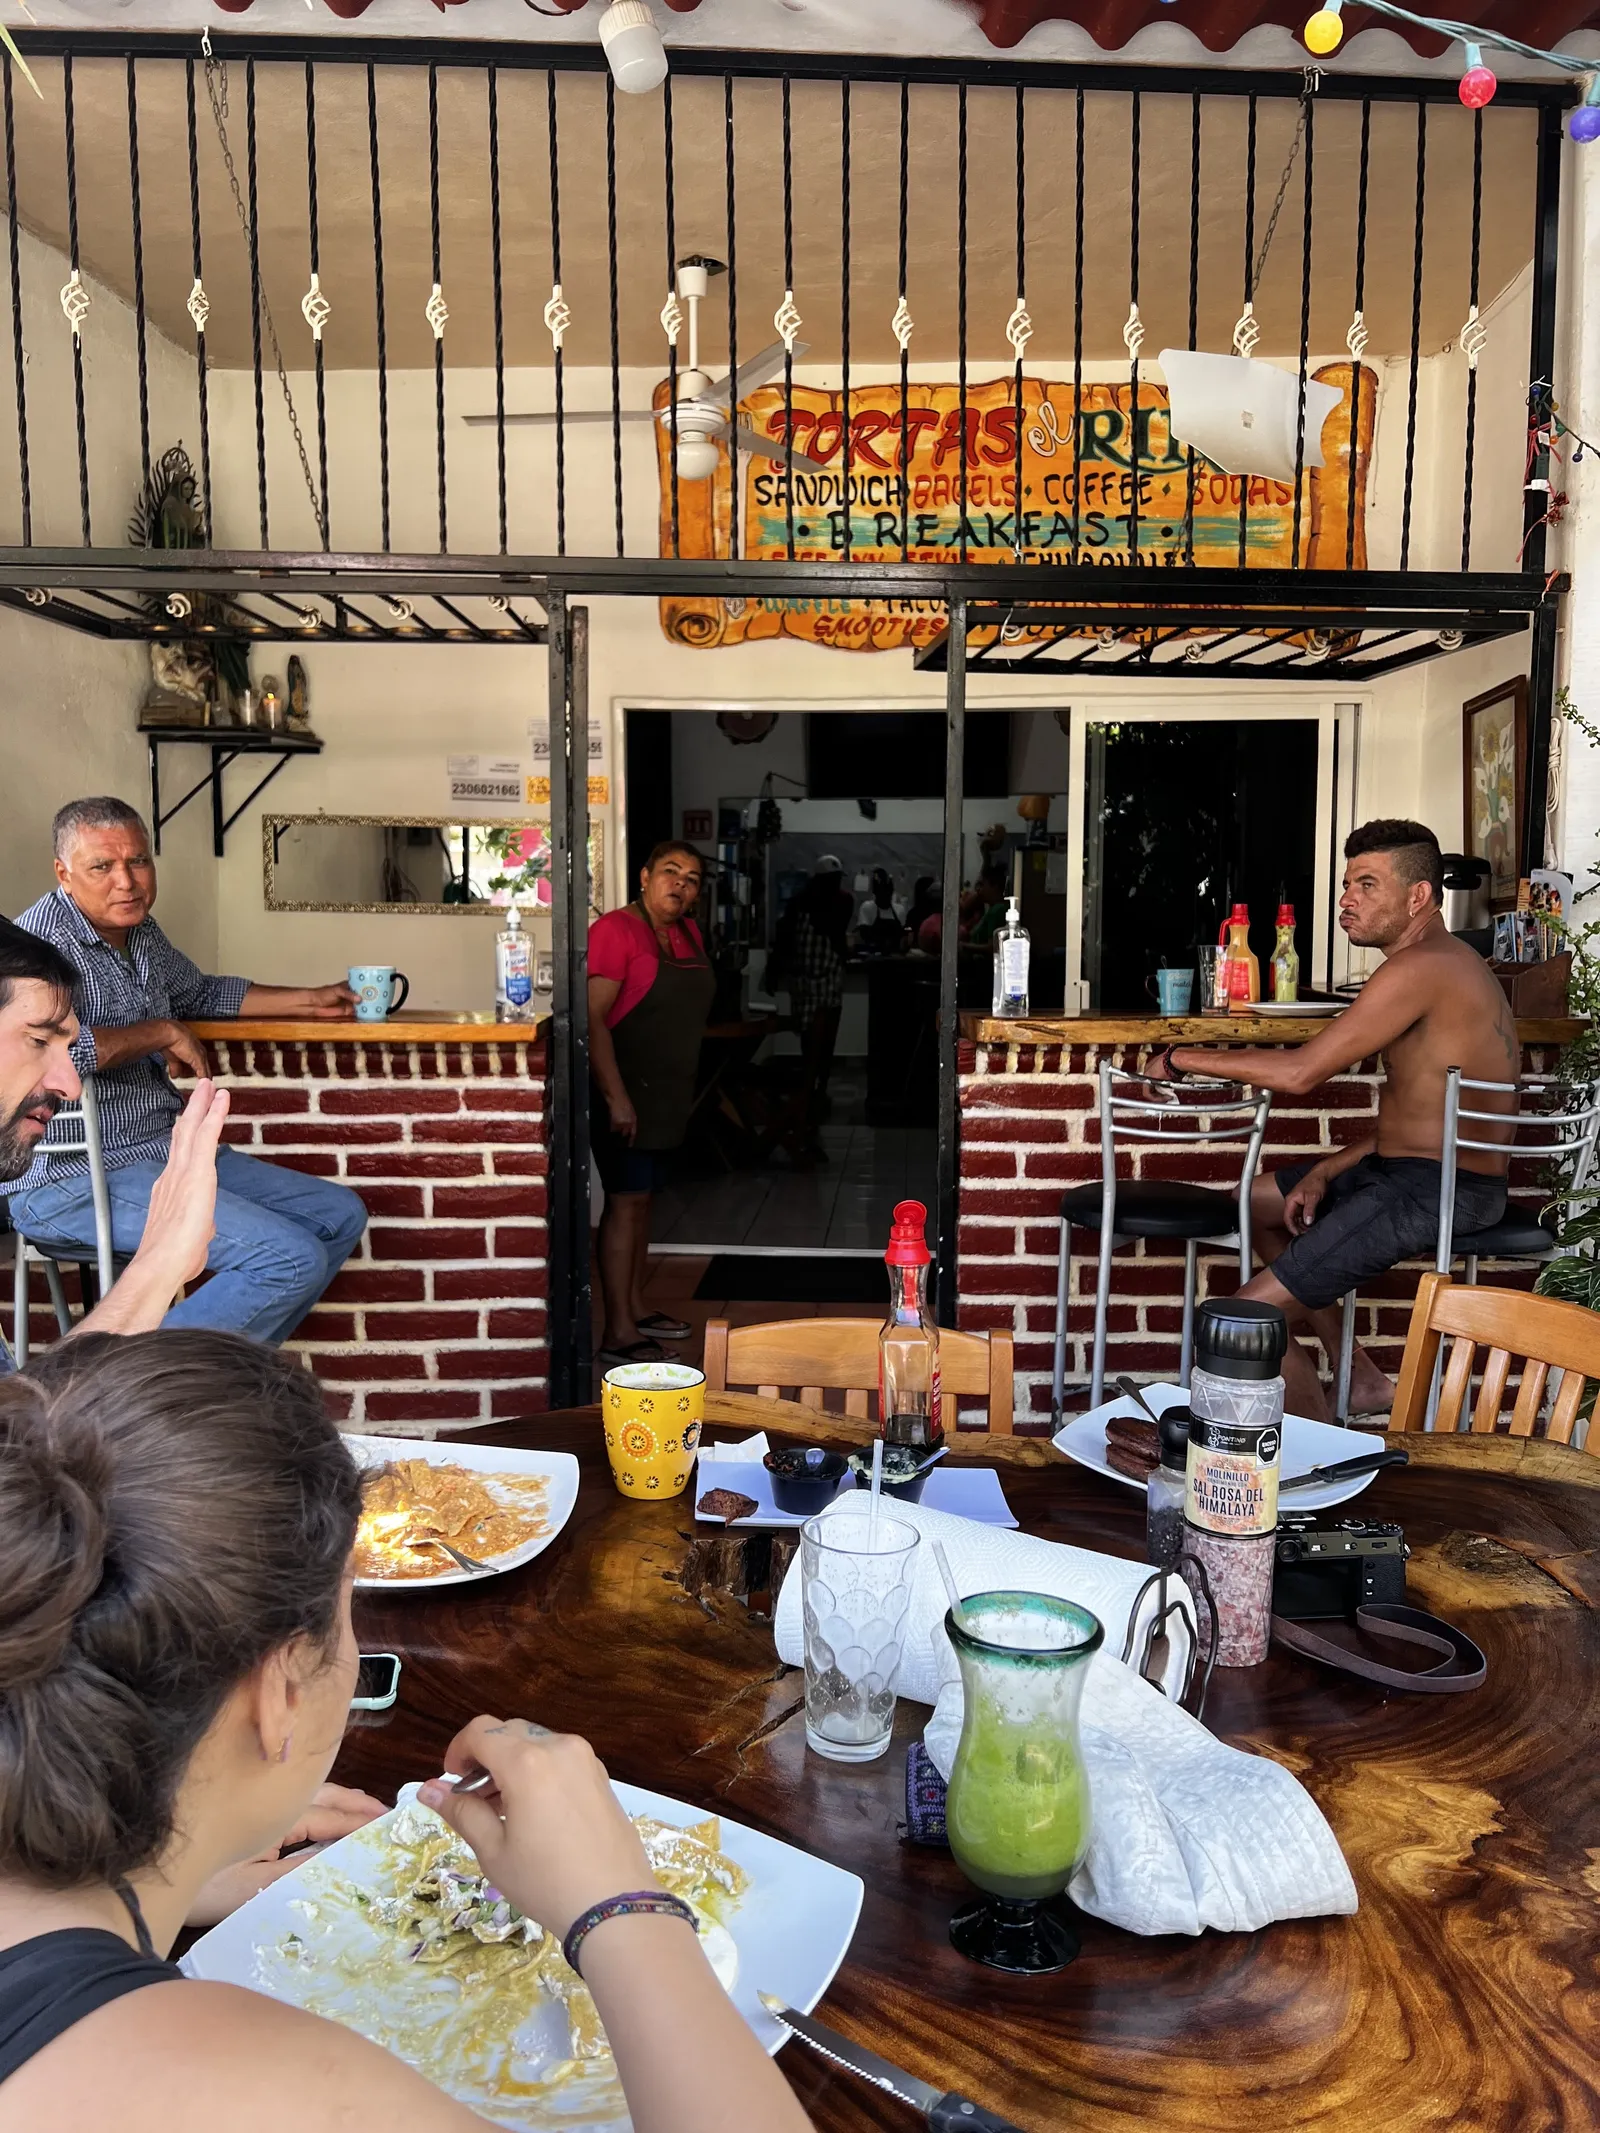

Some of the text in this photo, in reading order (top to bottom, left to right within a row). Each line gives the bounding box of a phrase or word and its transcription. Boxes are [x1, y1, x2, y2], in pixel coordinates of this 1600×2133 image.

[768, 408, 1026, 473] TORTAS
[754, 474, 908, 507] SANDWICH
[913, 473, 1017, 509] BAGELS
[1043, 472, 1154, 505] COFFEE
[826, 511, 1147, 549] BREAKFAST
[1206, 1467, 1250, 1482] MOLINILLO
[1193, 1478, 1264, 1502] SAL ROSA DEL
[1199, 1495, 1255, 1516] HIMALAYA
